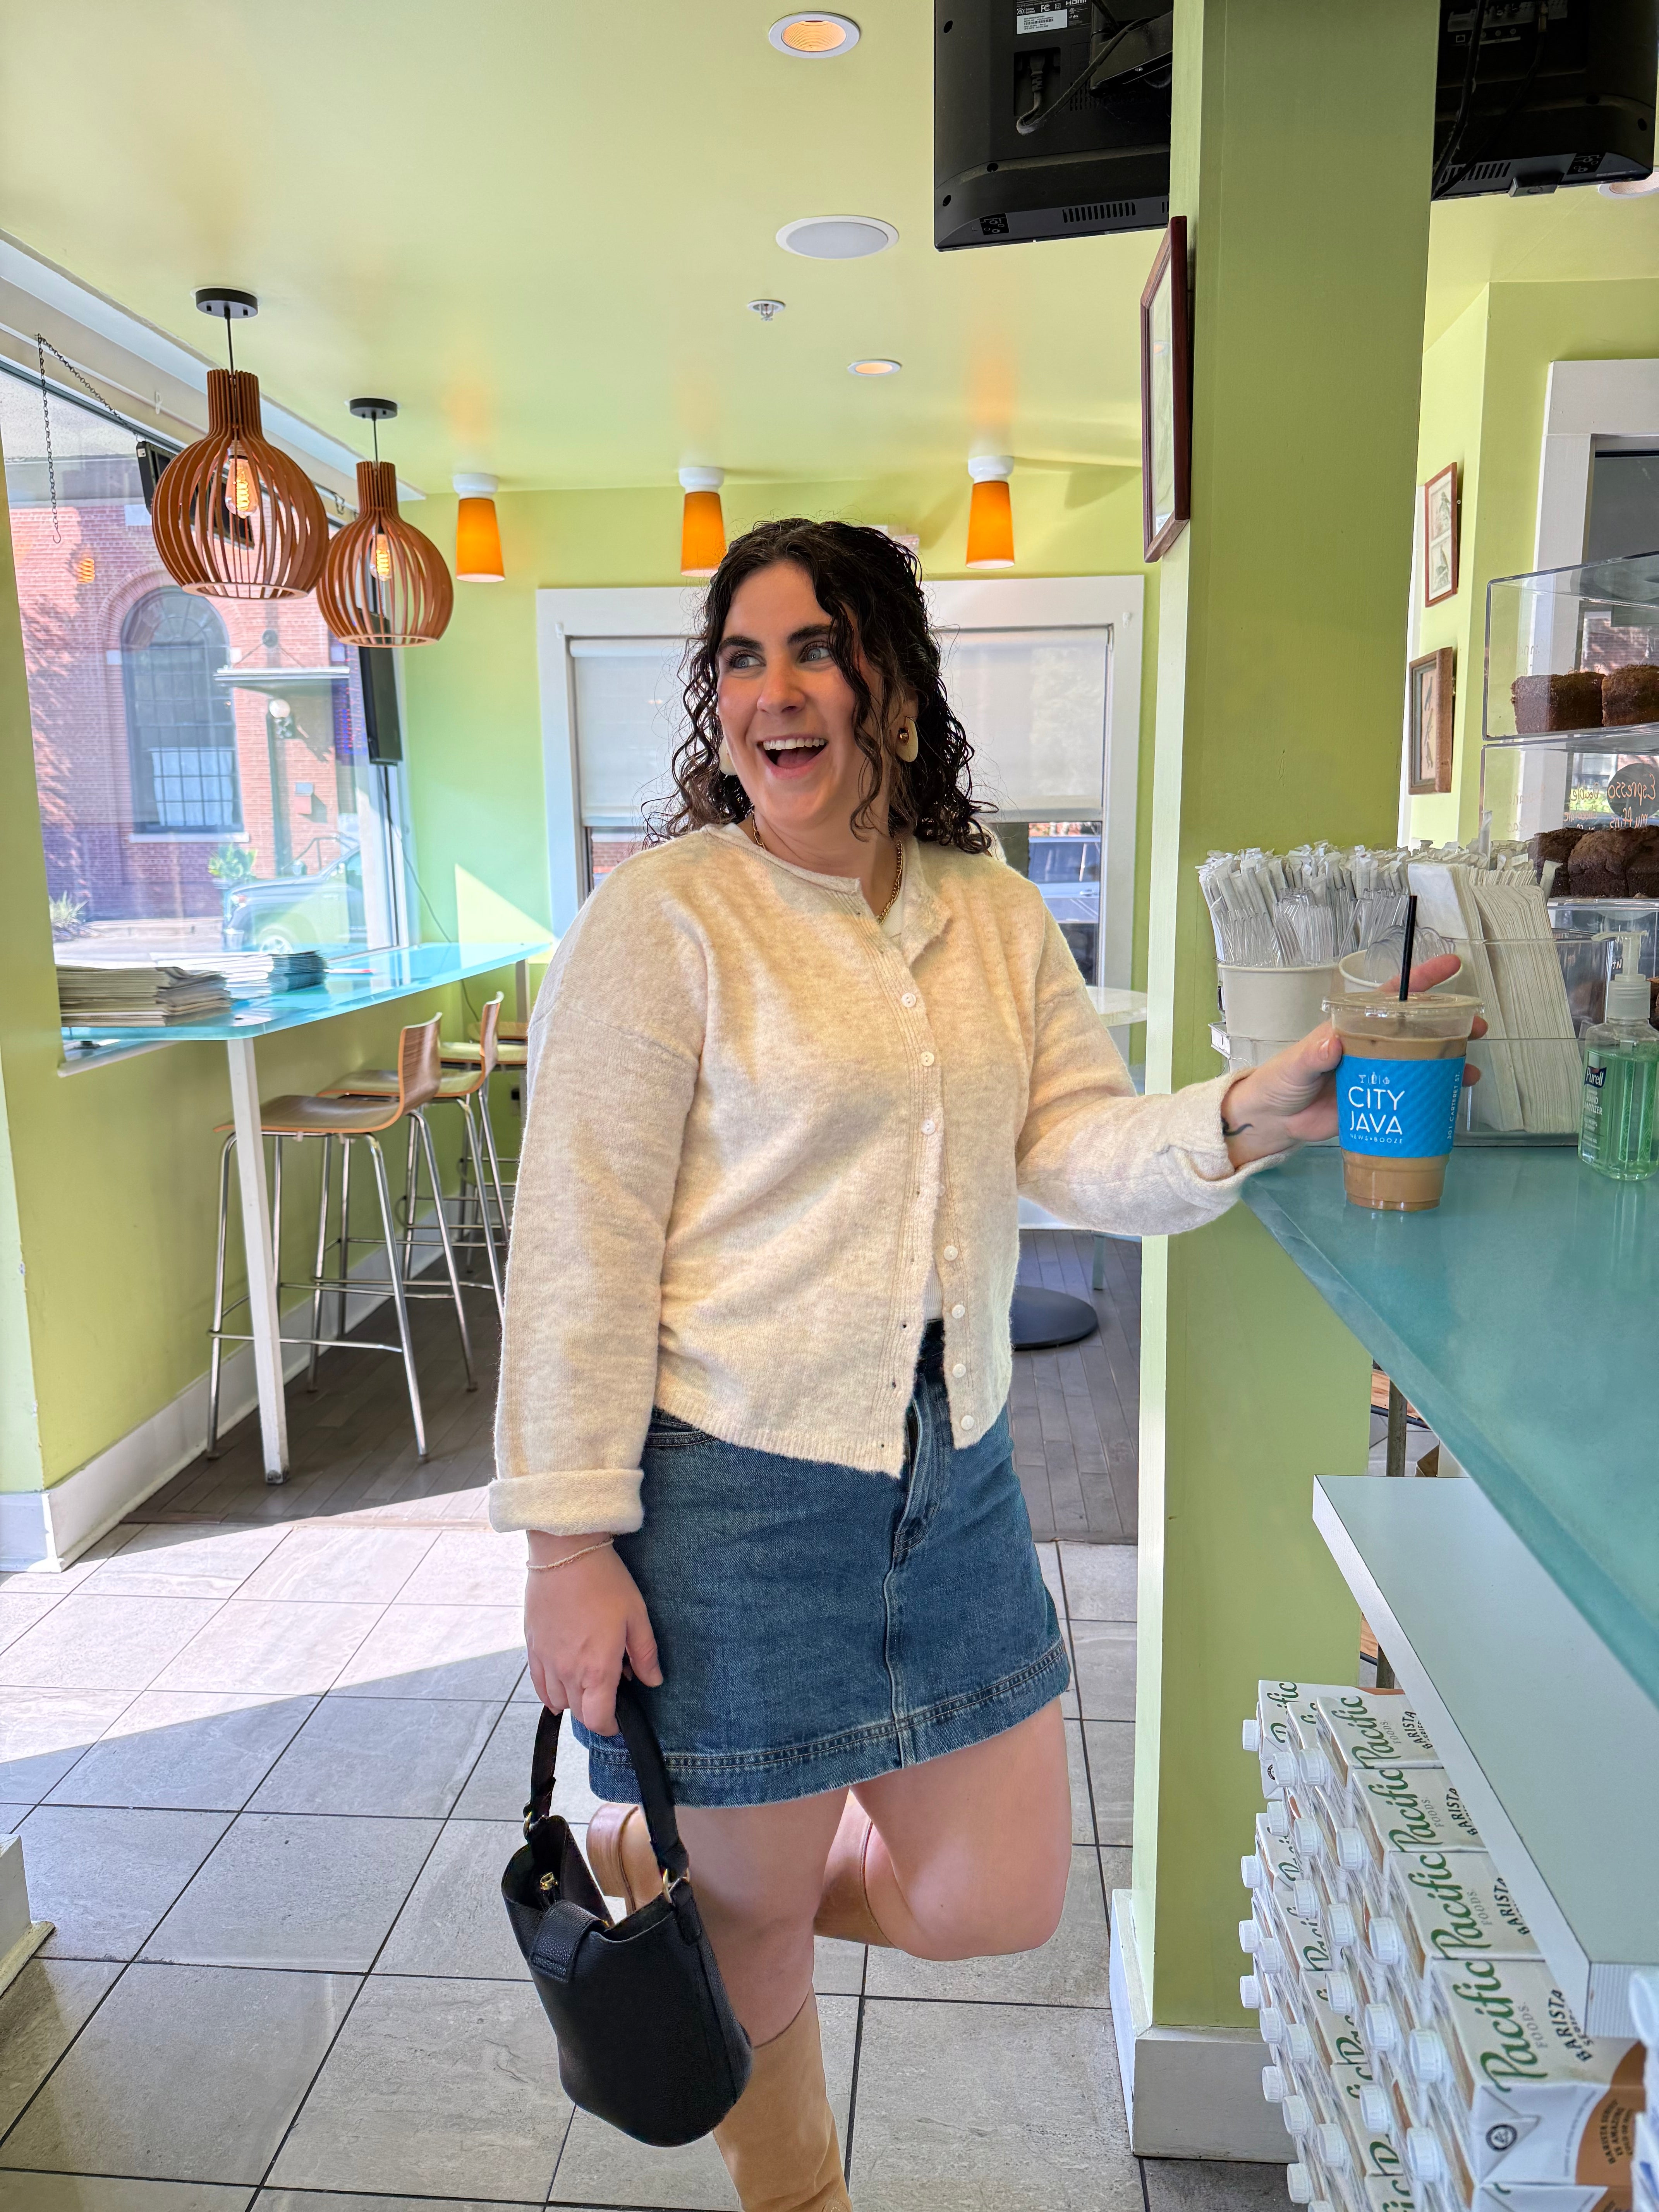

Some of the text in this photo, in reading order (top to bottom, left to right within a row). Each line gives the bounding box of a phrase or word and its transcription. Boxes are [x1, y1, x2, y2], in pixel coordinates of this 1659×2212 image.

[1348, 1086, 1405, 1110] CITY
[1586, 1067, 1604, 1086] Purell
[1350, 1111, 1403, 1135] JAVA
[1450, 1086, 1458, 1121] CARTERET
[1331, 1696, 1401, 1769] Pacific
[1402, 1711, 1433, 1749] BARISTA
[1368, 1769, 1443, 1852] Pacific
[1446, 1788, 1478, 1835] BARISTA
[1408, 1852, 1491, 1960] Pacific
[1494, 1877, 1530, 1934] BARISTA
[1453, 1961, 1547, 2092] Pacific
[1548, 1989, 1592, 2062] BARISTA
[1569, 2008, 1594, 2045] SERIE
